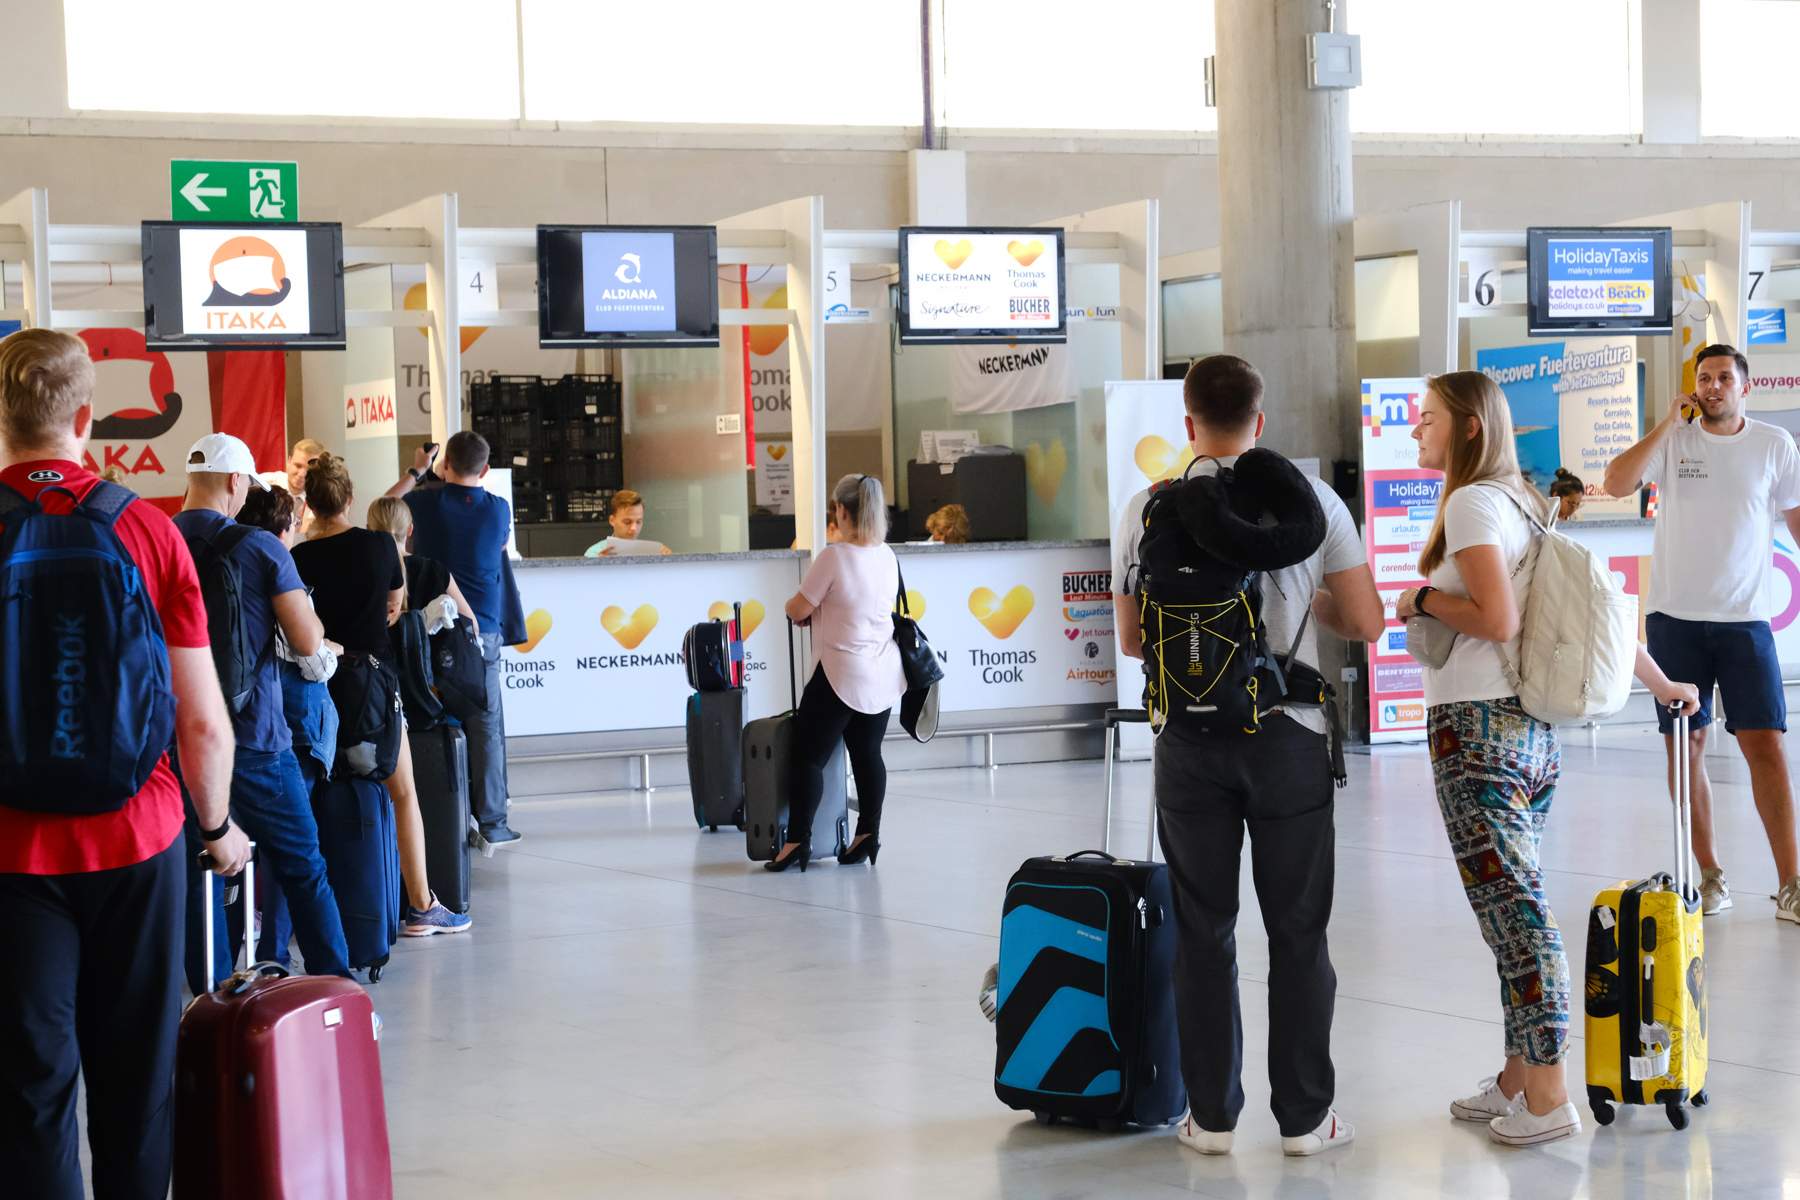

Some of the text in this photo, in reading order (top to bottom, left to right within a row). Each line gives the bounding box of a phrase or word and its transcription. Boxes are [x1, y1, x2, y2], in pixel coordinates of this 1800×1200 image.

[1554, 248, 1649, 267] HolidayTaxis
[916, 272, 992, 282] NECKERMANN
[1007, 268, 1046, 279] Thomas
[1568, 267, 1593, 275] making
[469, 271, 485, 293] 4
[826, 270, 837, 292] 5
[1013, 279, 1038, 288] Cook
[1475, 269, 1495, 306] 6
[1748, 271, 1764, 300] 7
[602, 288, 658, 300] ALDIANA
[1548, 285, 1604, 299] teletext
[1608, 287, 1646, 299] Beach
[596, 304, 612, 312] CLUB
[919, 300, 985, 319] Signature
[1009, 299, 1050, 313] BUCHER
[206, 311, 287, 330] ITAKA
[1539, 344, 1632, 377] Fuerteventura
[1552, 368, 1625, 394] with Jet2holidays!
[1588, 396, 1632, 406] Resorts include
[361, 395, 394, 424] ITAKA
[1594, 422, 1611, 431] Costa
[1594, 435, 1611, 443] Costa
[1581, 447, 1598, 456] Costa
[1389, 481, 1444, 499] HolidayT
[1400, 498, 1421, 506] making
[1381, 562, 1416, 572] corendon
[1063, 573, 1112, 593] BUCHER
[577, 652, 685, 669] NECKERMANN
[968, 649, 1037, 666] Thomas
[505, 674, 545, 689] Cook
[982, 666, 1024, 684] Cook
[1066, 668, 1116, 681] Airtours
[52, 613, 87, 760] Reebok
[1398, 709, 1422, 718] tropo
